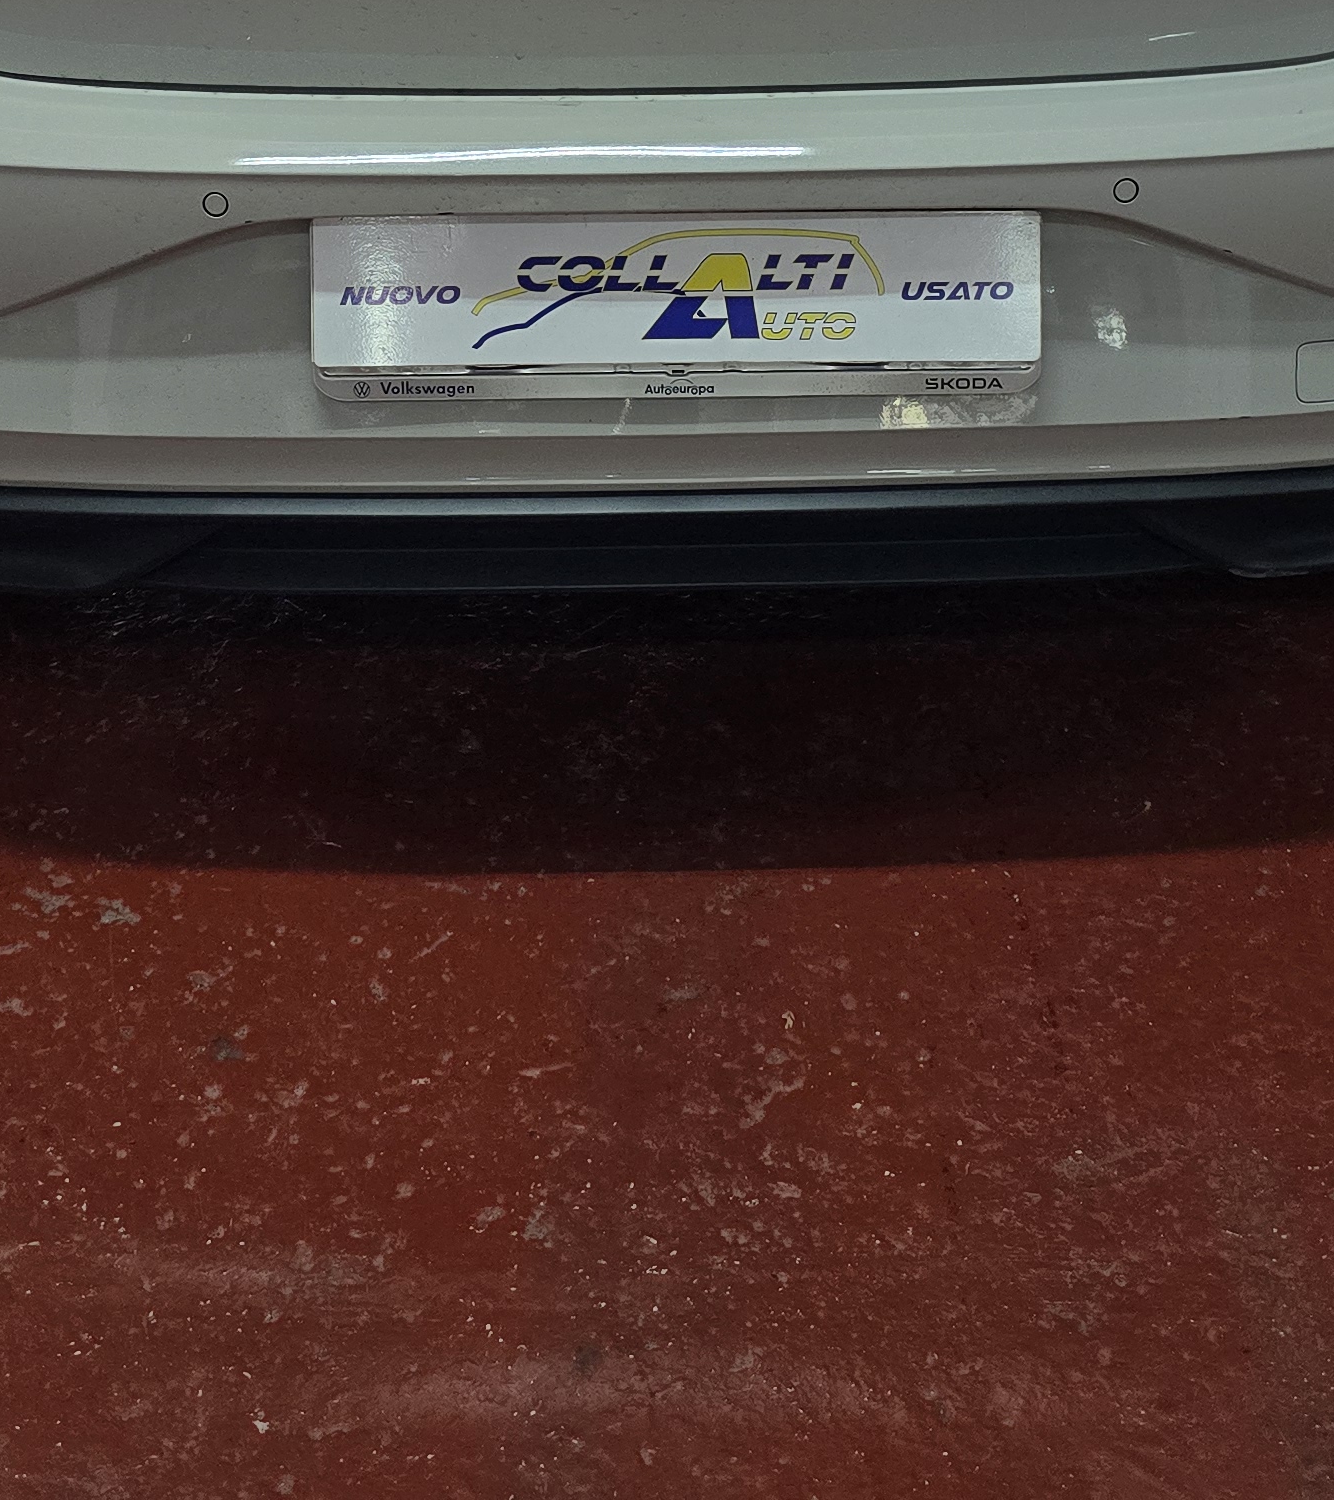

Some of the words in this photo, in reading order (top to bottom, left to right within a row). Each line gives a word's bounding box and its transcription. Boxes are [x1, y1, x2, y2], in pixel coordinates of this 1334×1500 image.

[340, 286, 461, 306] NUOVO
[901, 281, 1015, 301] USATO
[380, 380, 475, 397] Volkswagen
[646, 383, 715, 396] Autoeuropa
